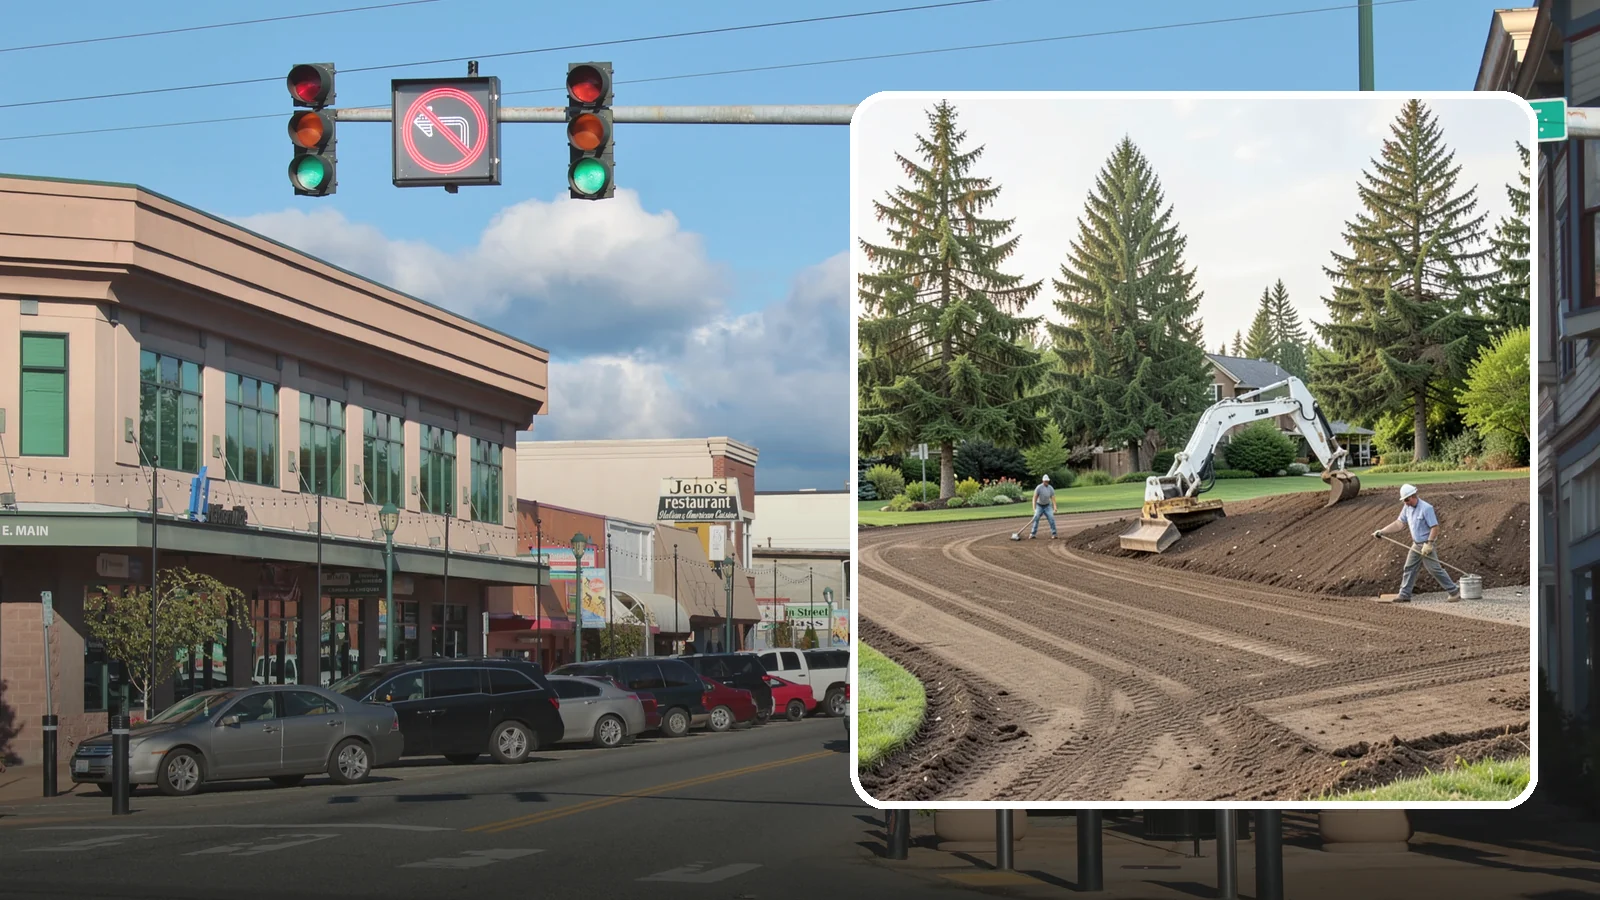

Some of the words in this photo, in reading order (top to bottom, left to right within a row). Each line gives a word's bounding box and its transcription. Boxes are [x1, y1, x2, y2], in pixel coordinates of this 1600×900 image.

[670, 480, 728, 494] Jeno's
[665, 496, 731, 509] restaurant
[658, 510, 682, 519] Italian
[686, 509, 714, 519] American
[715, 509, 737, 519] Cuisine
[2, 525, 13, 536] E.
[15, 525, 49, 536] MAIN
[797, 607, 828, 617] Street
